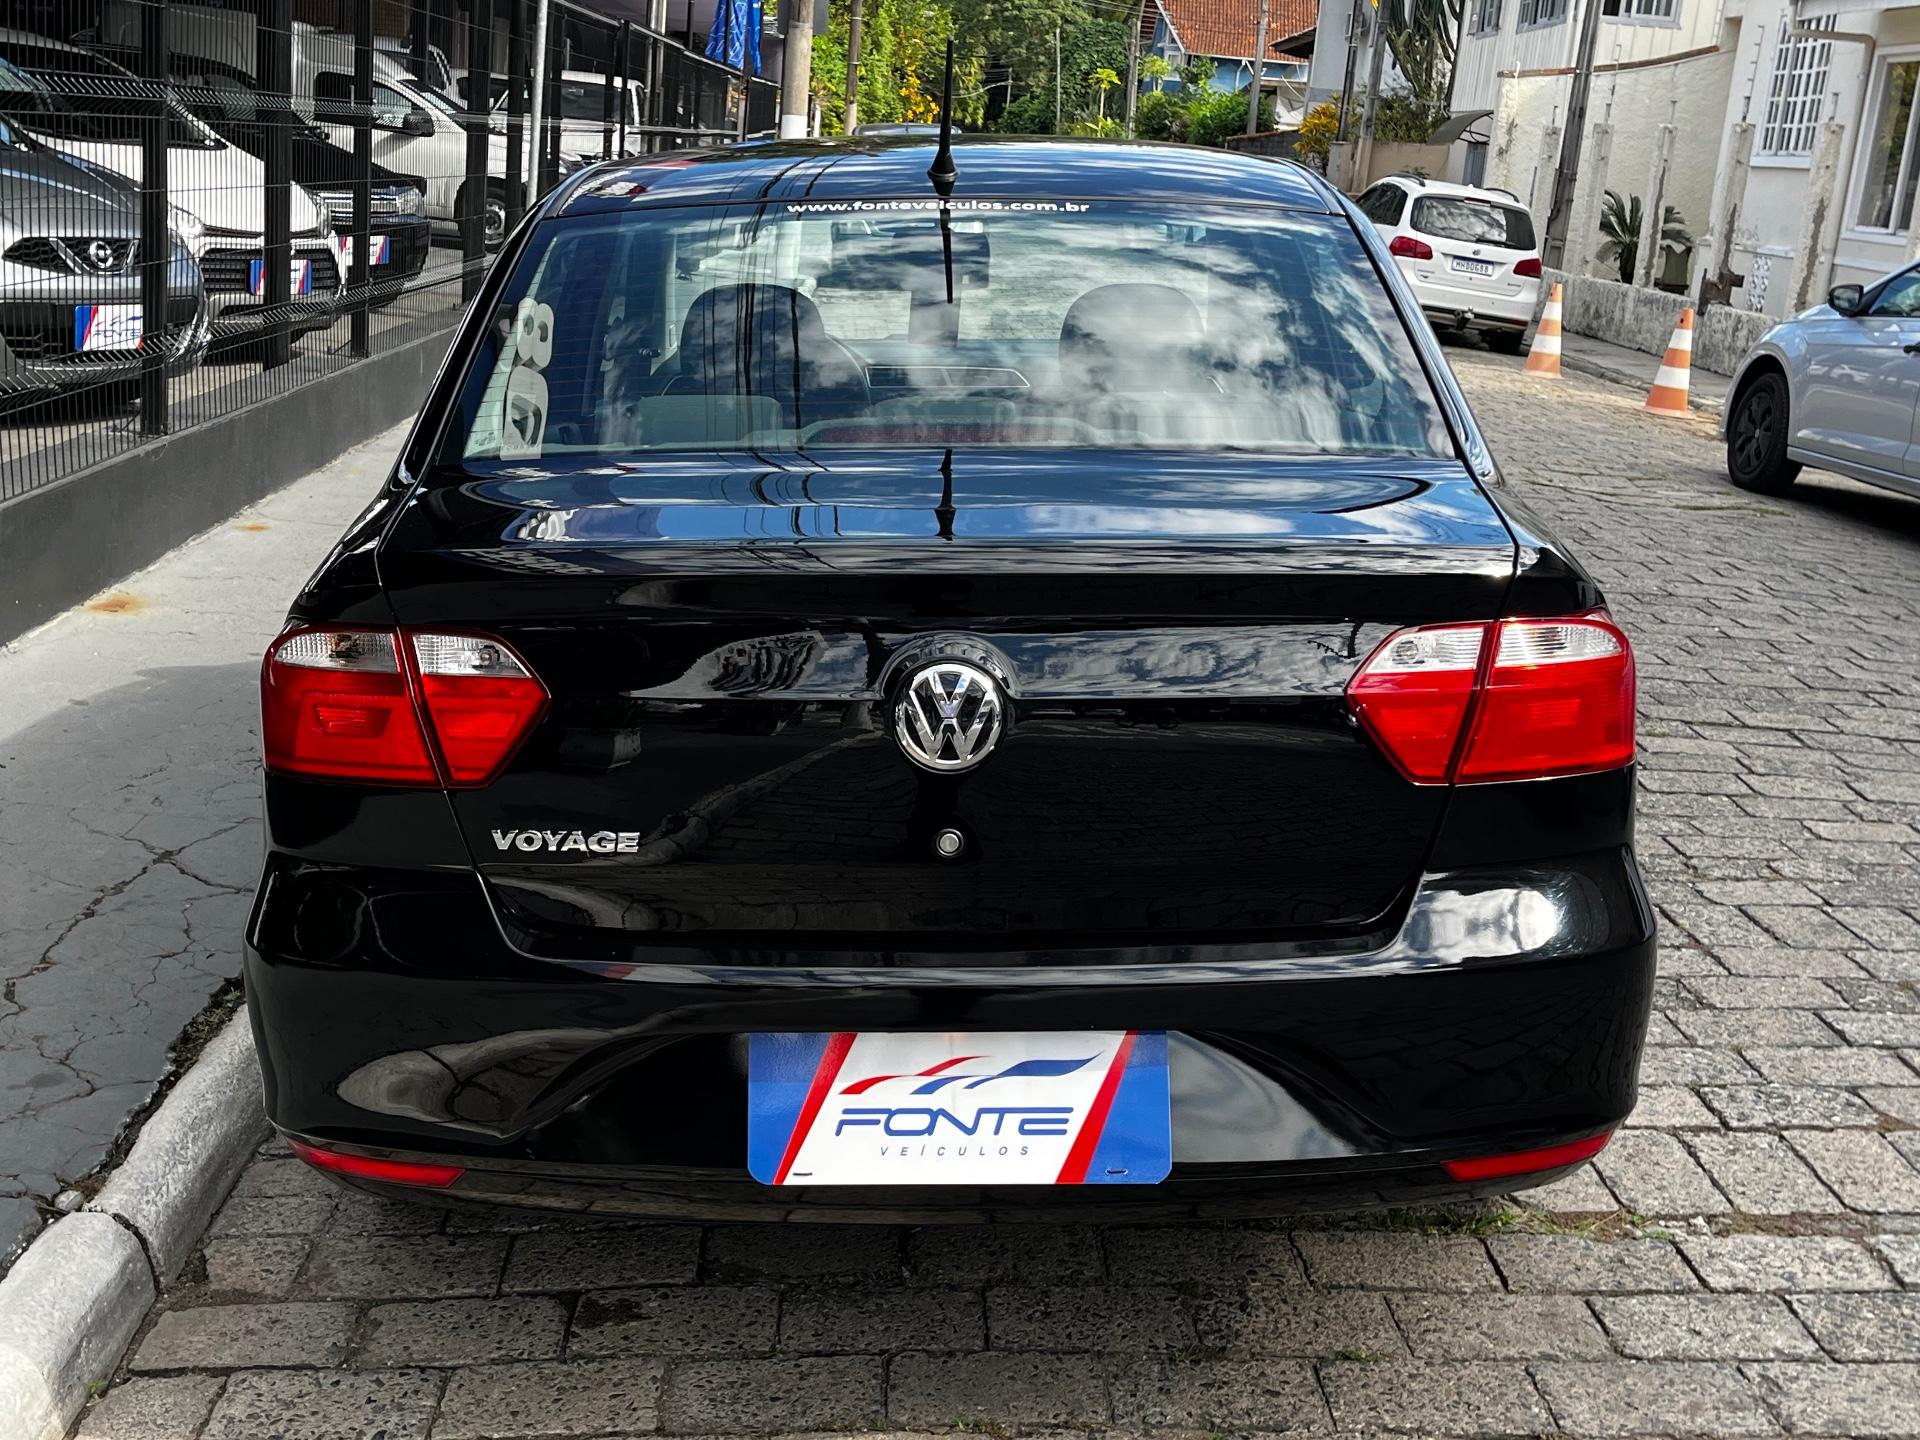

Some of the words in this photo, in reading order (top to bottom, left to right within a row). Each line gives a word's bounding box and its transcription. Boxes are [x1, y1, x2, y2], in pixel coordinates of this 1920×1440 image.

[491, 829, 641, 853] VOYAGE
[835, 1107, 1074, 1136] FONTE
[880, 1144, 1029, 1156] VEÍCULOS
